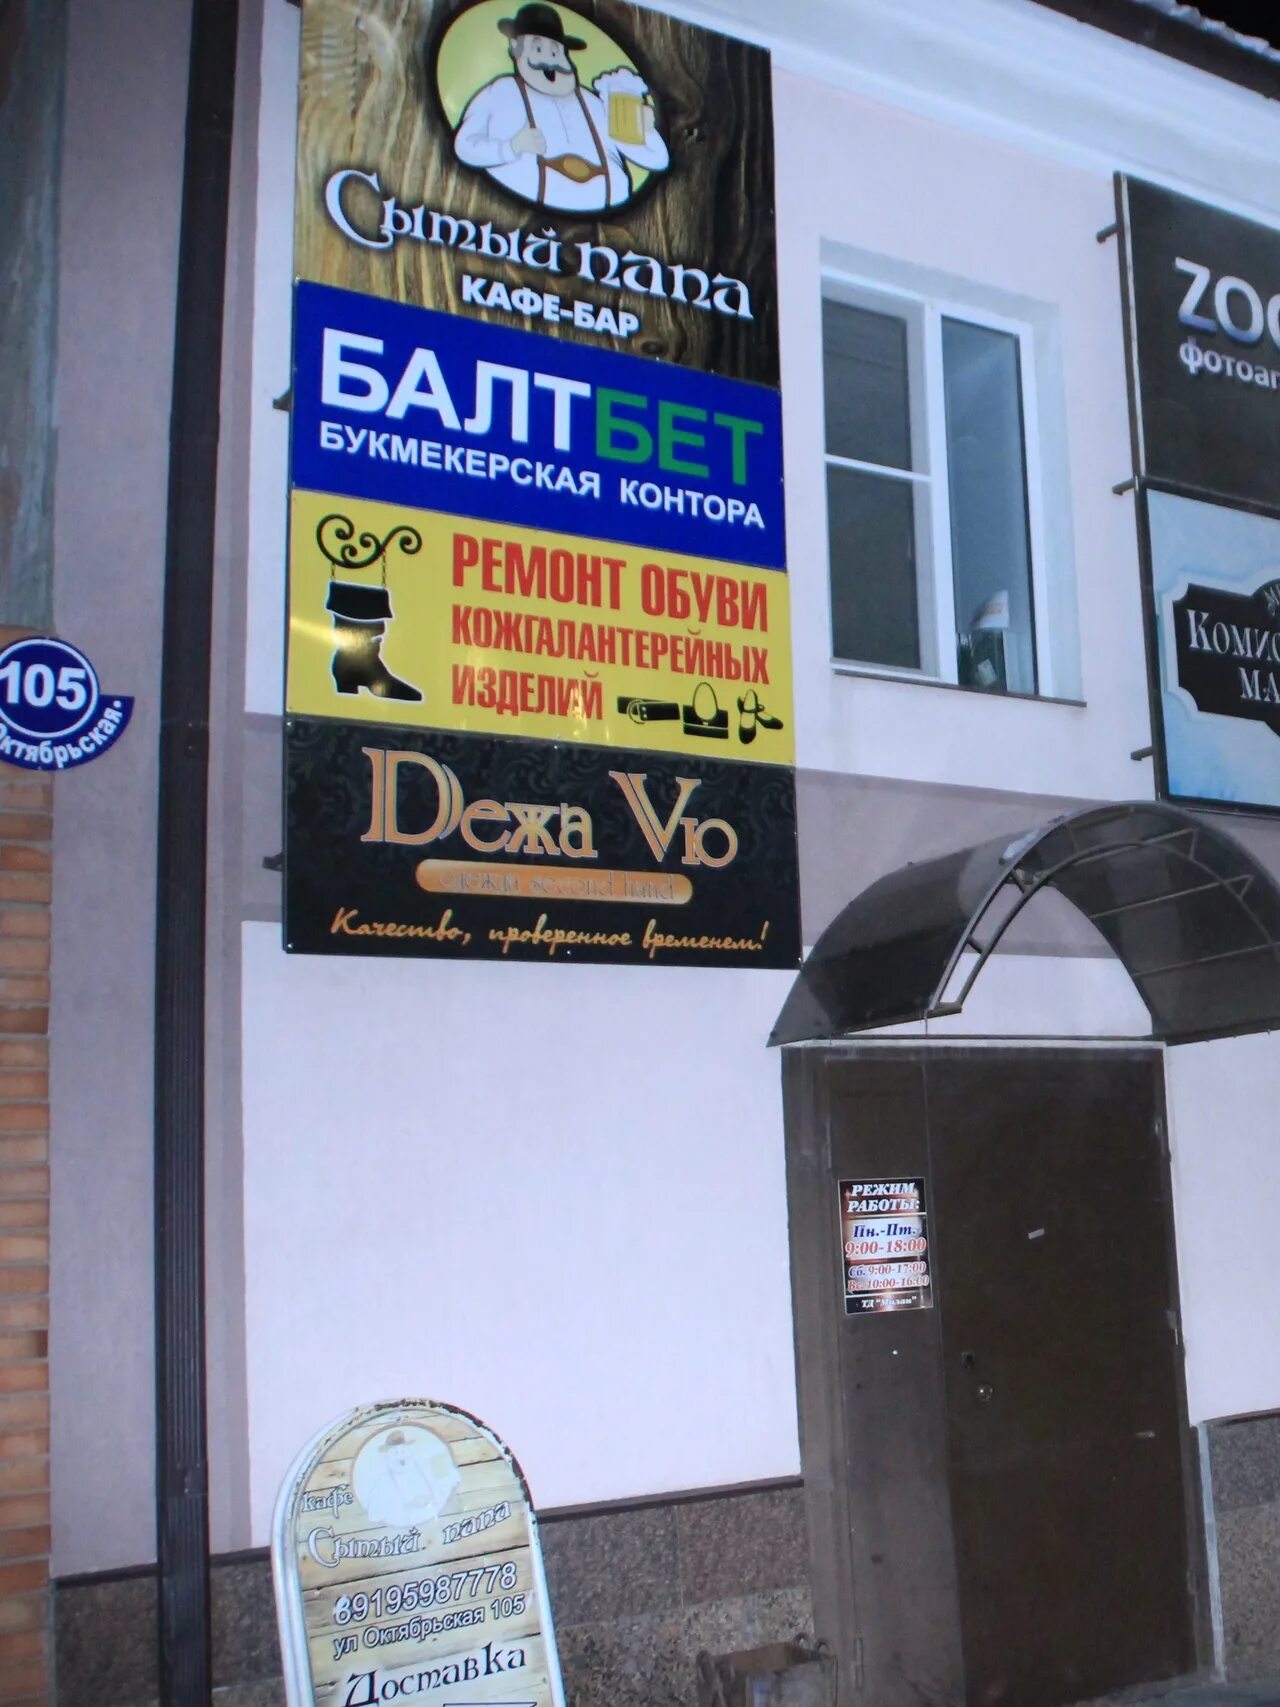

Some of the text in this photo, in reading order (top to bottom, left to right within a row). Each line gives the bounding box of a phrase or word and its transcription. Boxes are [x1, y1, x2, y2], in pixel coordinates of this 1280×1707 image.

[325, 169, 755, 320] Сытый папа
[461, 274, 640, 338] КАФЕ-БАР
[321, 327, 763, 486] БАЛТБЕТ
[319, 420, 766, 530] БУКМЕКЕРСКАЯ КОНТОРА
[451, 532, 769, 633] РЕМОНТ ОБУВИ
[451, 603, 770, 685] КОЖГАЛАНТЕРЕЙНЫХ
[0, 660, 87, 710] 105
[451, 663, 604, 720] ИЗДЕЛИЙ
[330, 906, 770, 959] Качество, проверенное временем!
[847, 1198, 920, 1213] РАБОТЫ:
[851, 1182, 916, 1197] РЕЖИМ
[845, 1238, 927, 1257] 9:00-18:00
[848, 1266, 866, 1278] Сб.
[301, 1484, 353, 1518] кафе
[307, 1500, 511, 1568] Сытый папа
[334, 1562, 517, 1625] 89195987778
[333, 1594, 525, 1661] ул Октябрьская 105
[343, 1641, 526, 1706] Доставка
